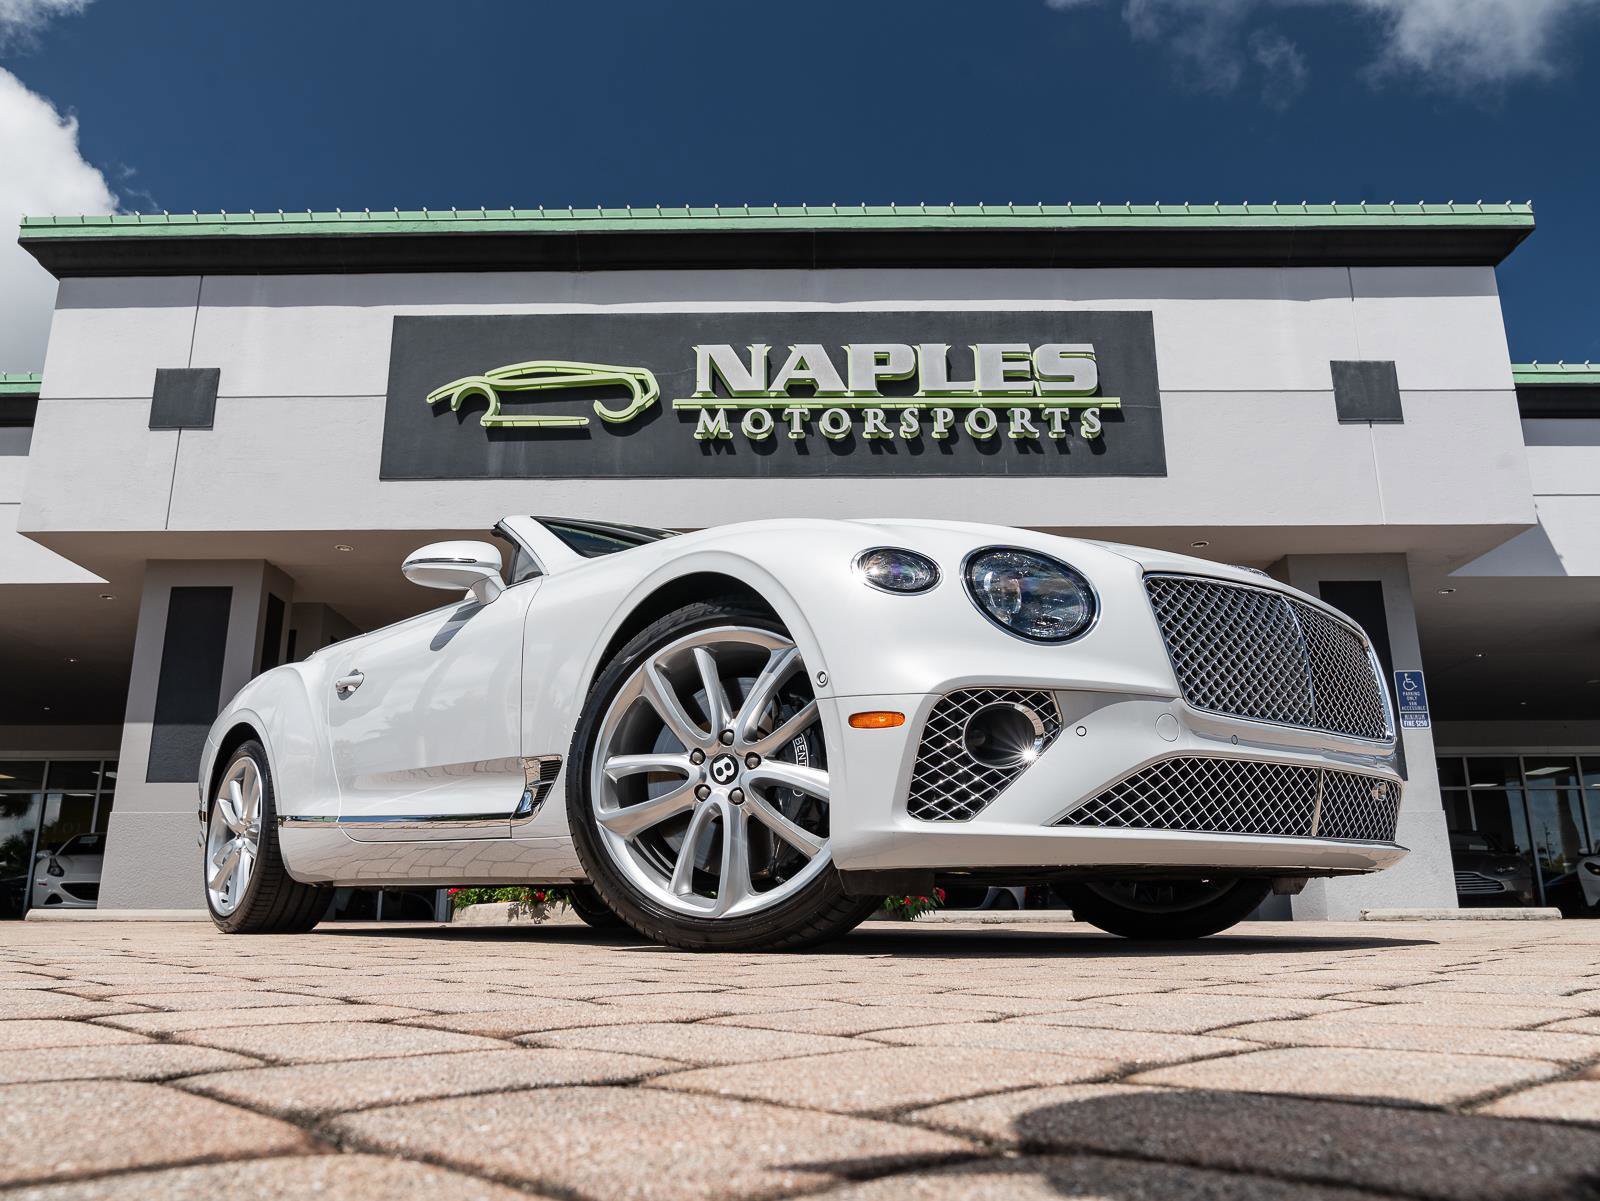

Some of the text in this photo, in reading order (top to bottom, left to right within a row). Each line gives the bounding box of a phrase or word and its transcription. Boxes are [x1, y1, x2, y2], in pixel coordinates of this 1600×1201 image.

[691, 343, 1099, 397] NAPLES
[694, 407, 1103, 439] MOTORSPORTS
[713, 756, 735, 782] B
